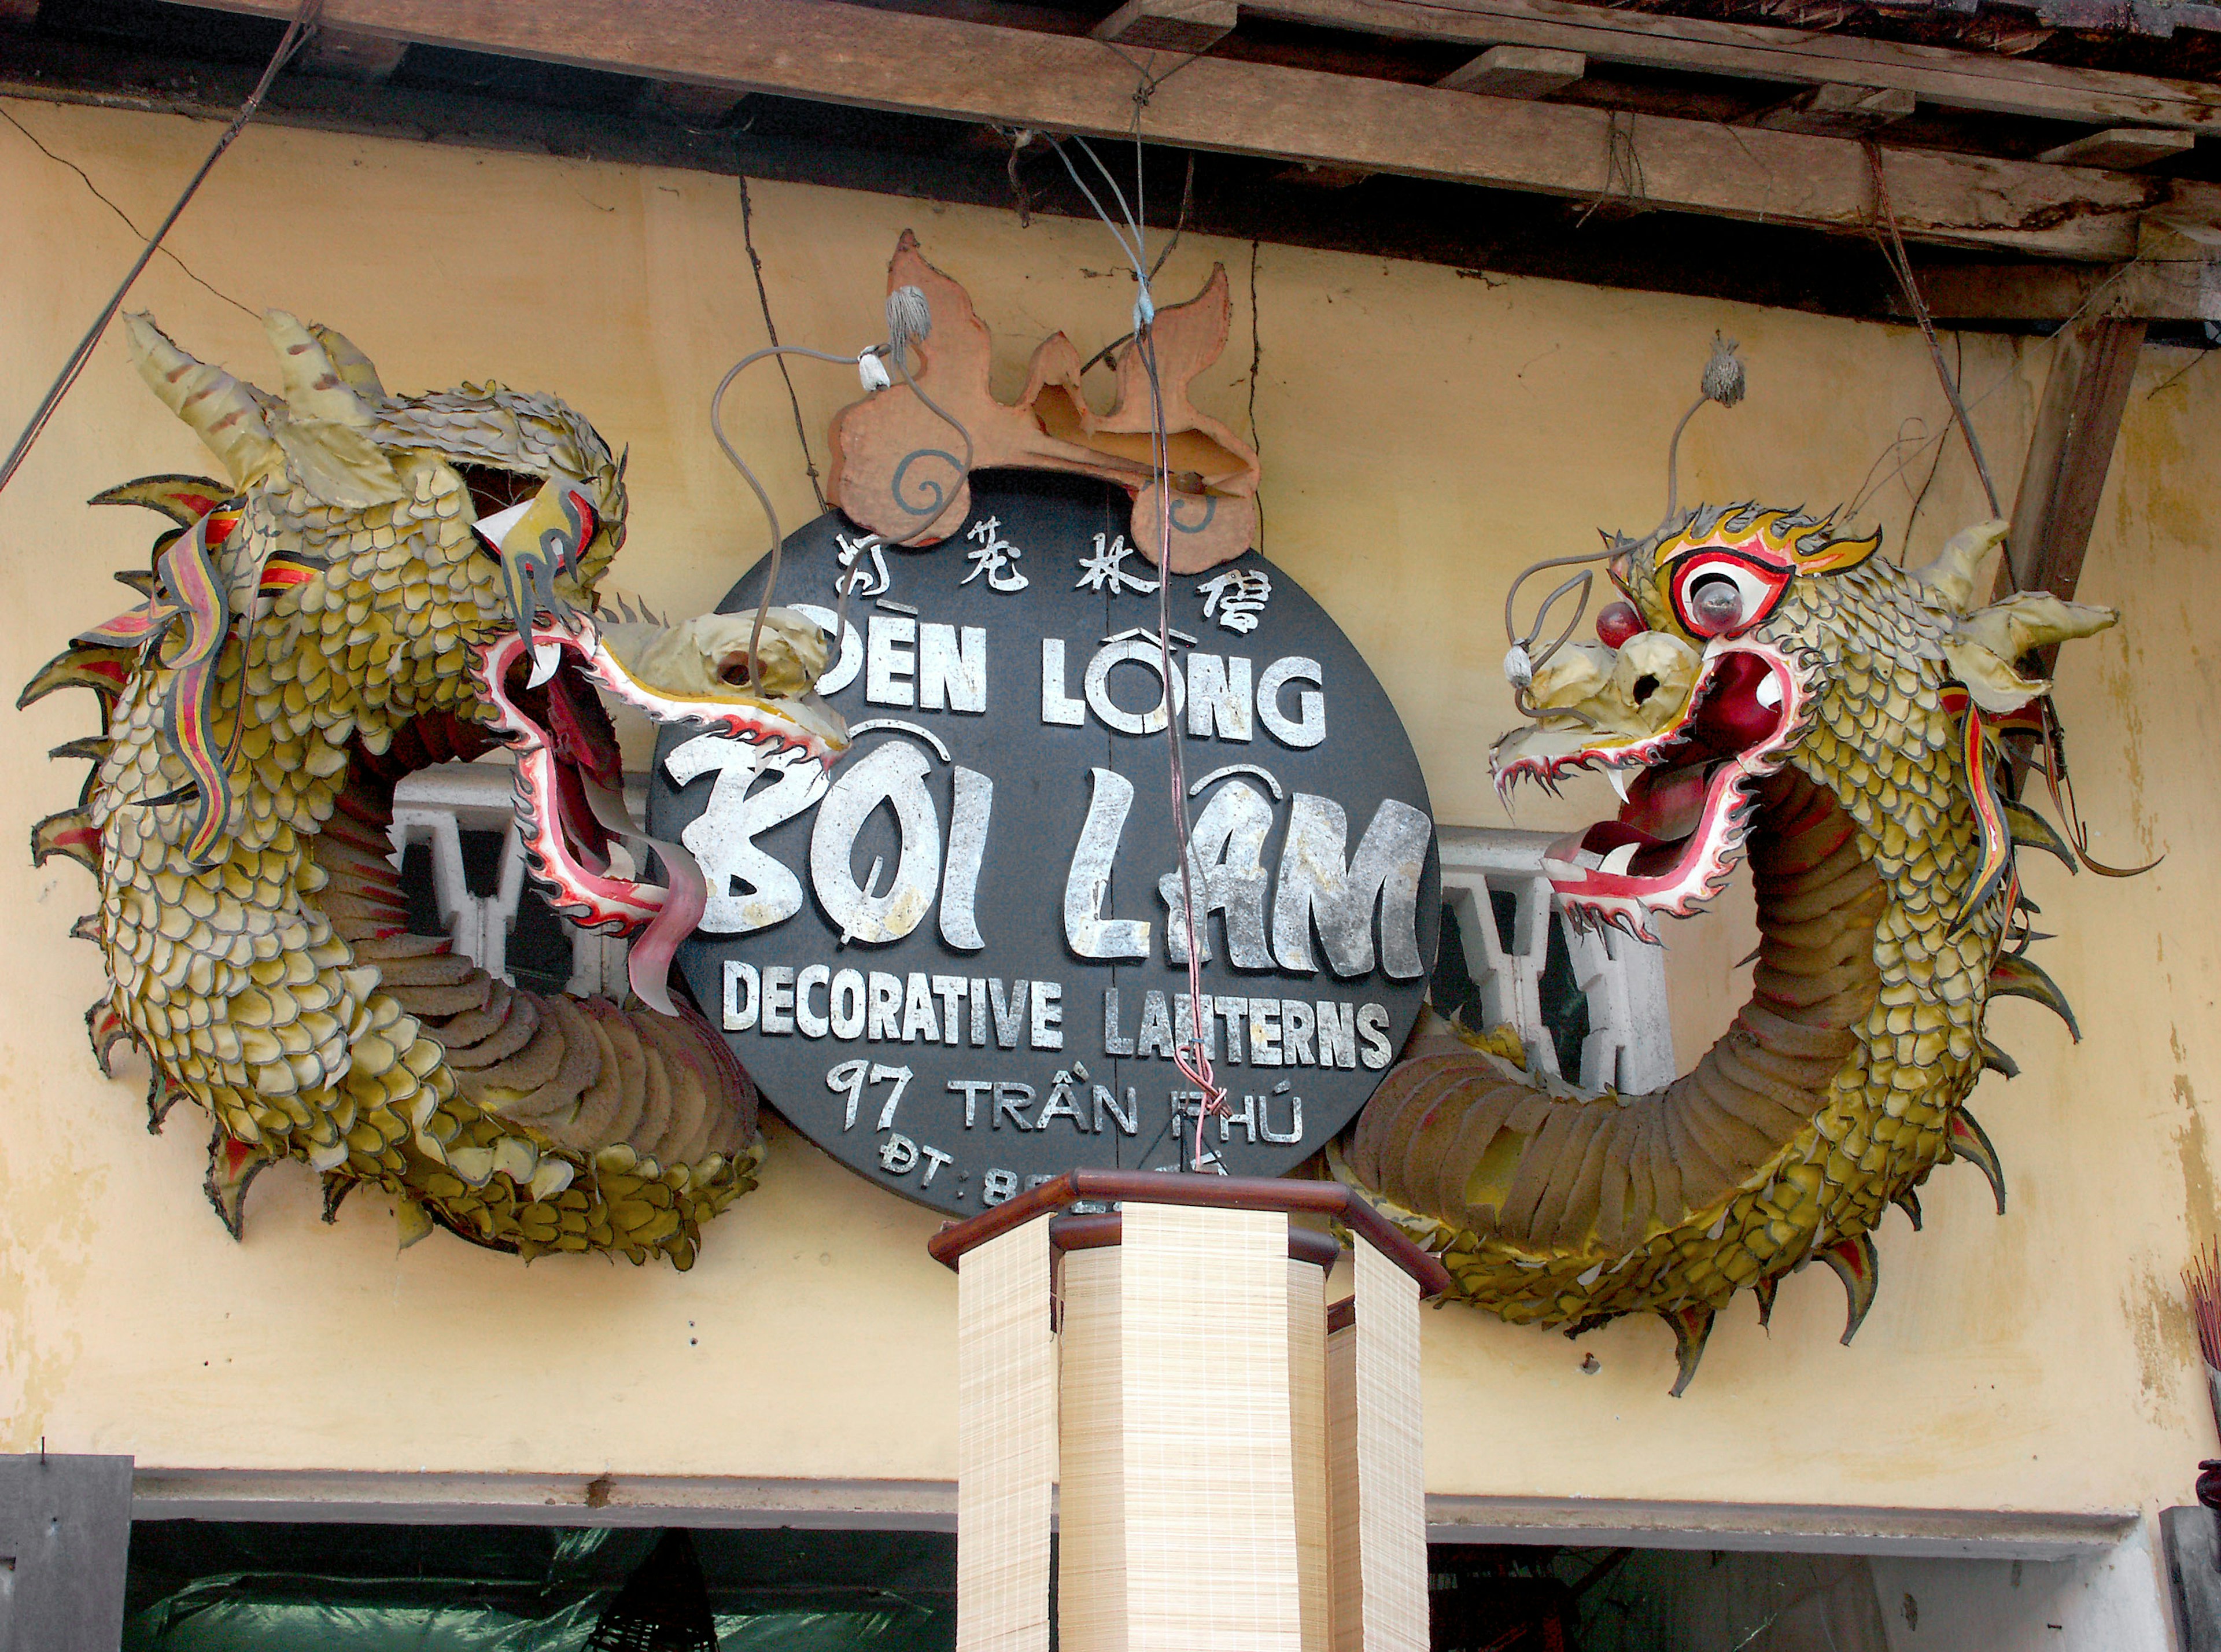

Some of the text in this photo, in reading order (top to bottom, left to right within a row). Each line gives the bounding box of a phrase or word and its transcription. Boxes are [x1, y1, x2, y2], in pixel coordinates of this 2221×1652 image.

[1063, 764, 1432, 979] LÂM
[723, 960, 1393, 1069] DECORATIVE LANTERNS
[826, 1060, 914, 1131] 97
[947, 1061, 1138, 1135] TRẦN
